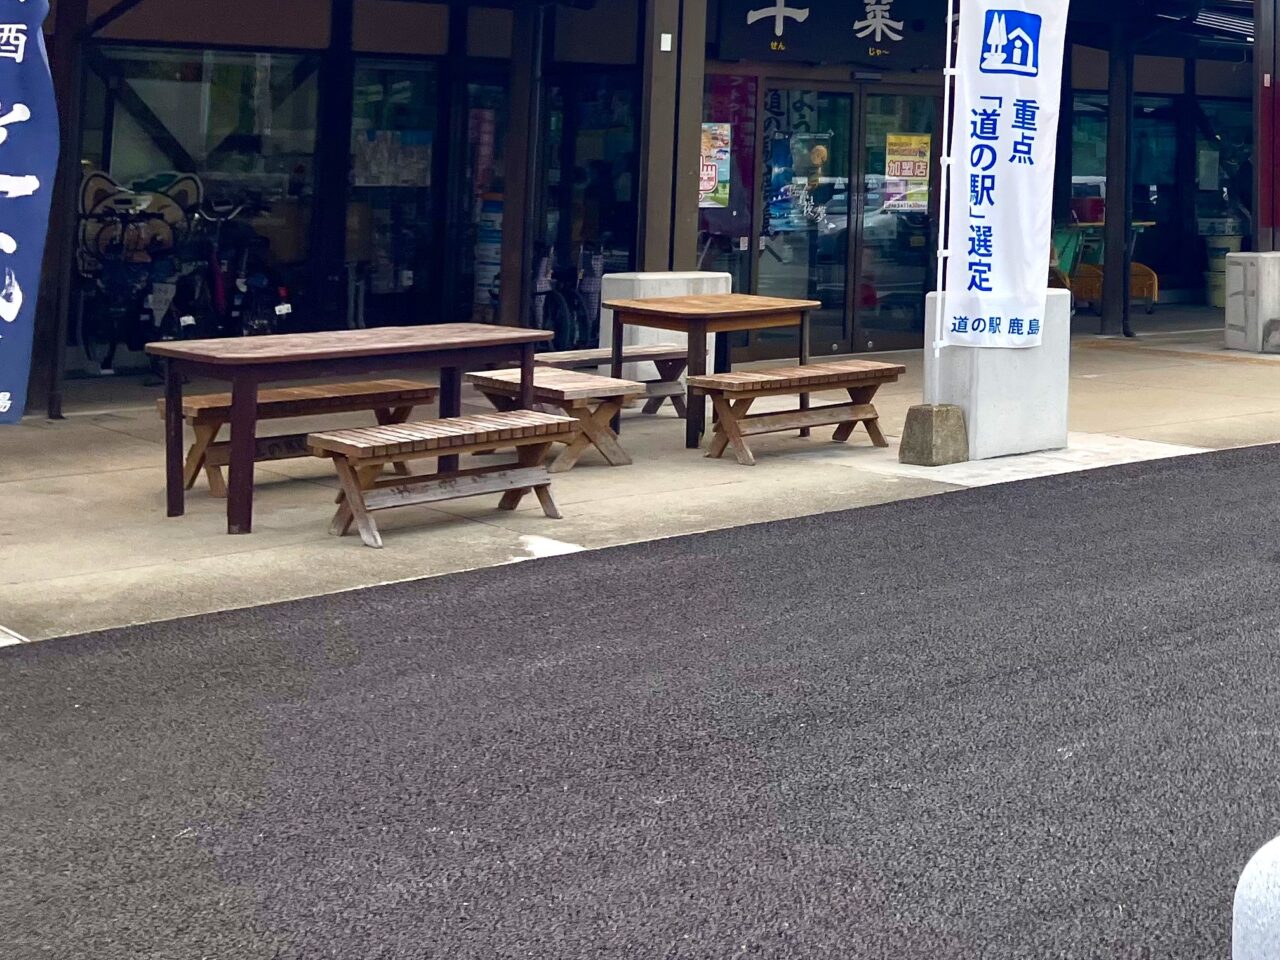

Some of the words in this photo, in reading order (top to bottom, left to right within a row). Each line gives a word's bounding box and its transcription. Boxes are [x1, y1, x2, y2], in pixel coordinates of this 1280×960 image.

[1008, 99, 1040, 165] 重点
[888, 160, 928, 177] 加盟店
[967, 95, 1003, 292] 「道の駅」選定
[951, 316, 1001, 334] 道の駅
[1008, 317, 1040, 336] 鹿島
